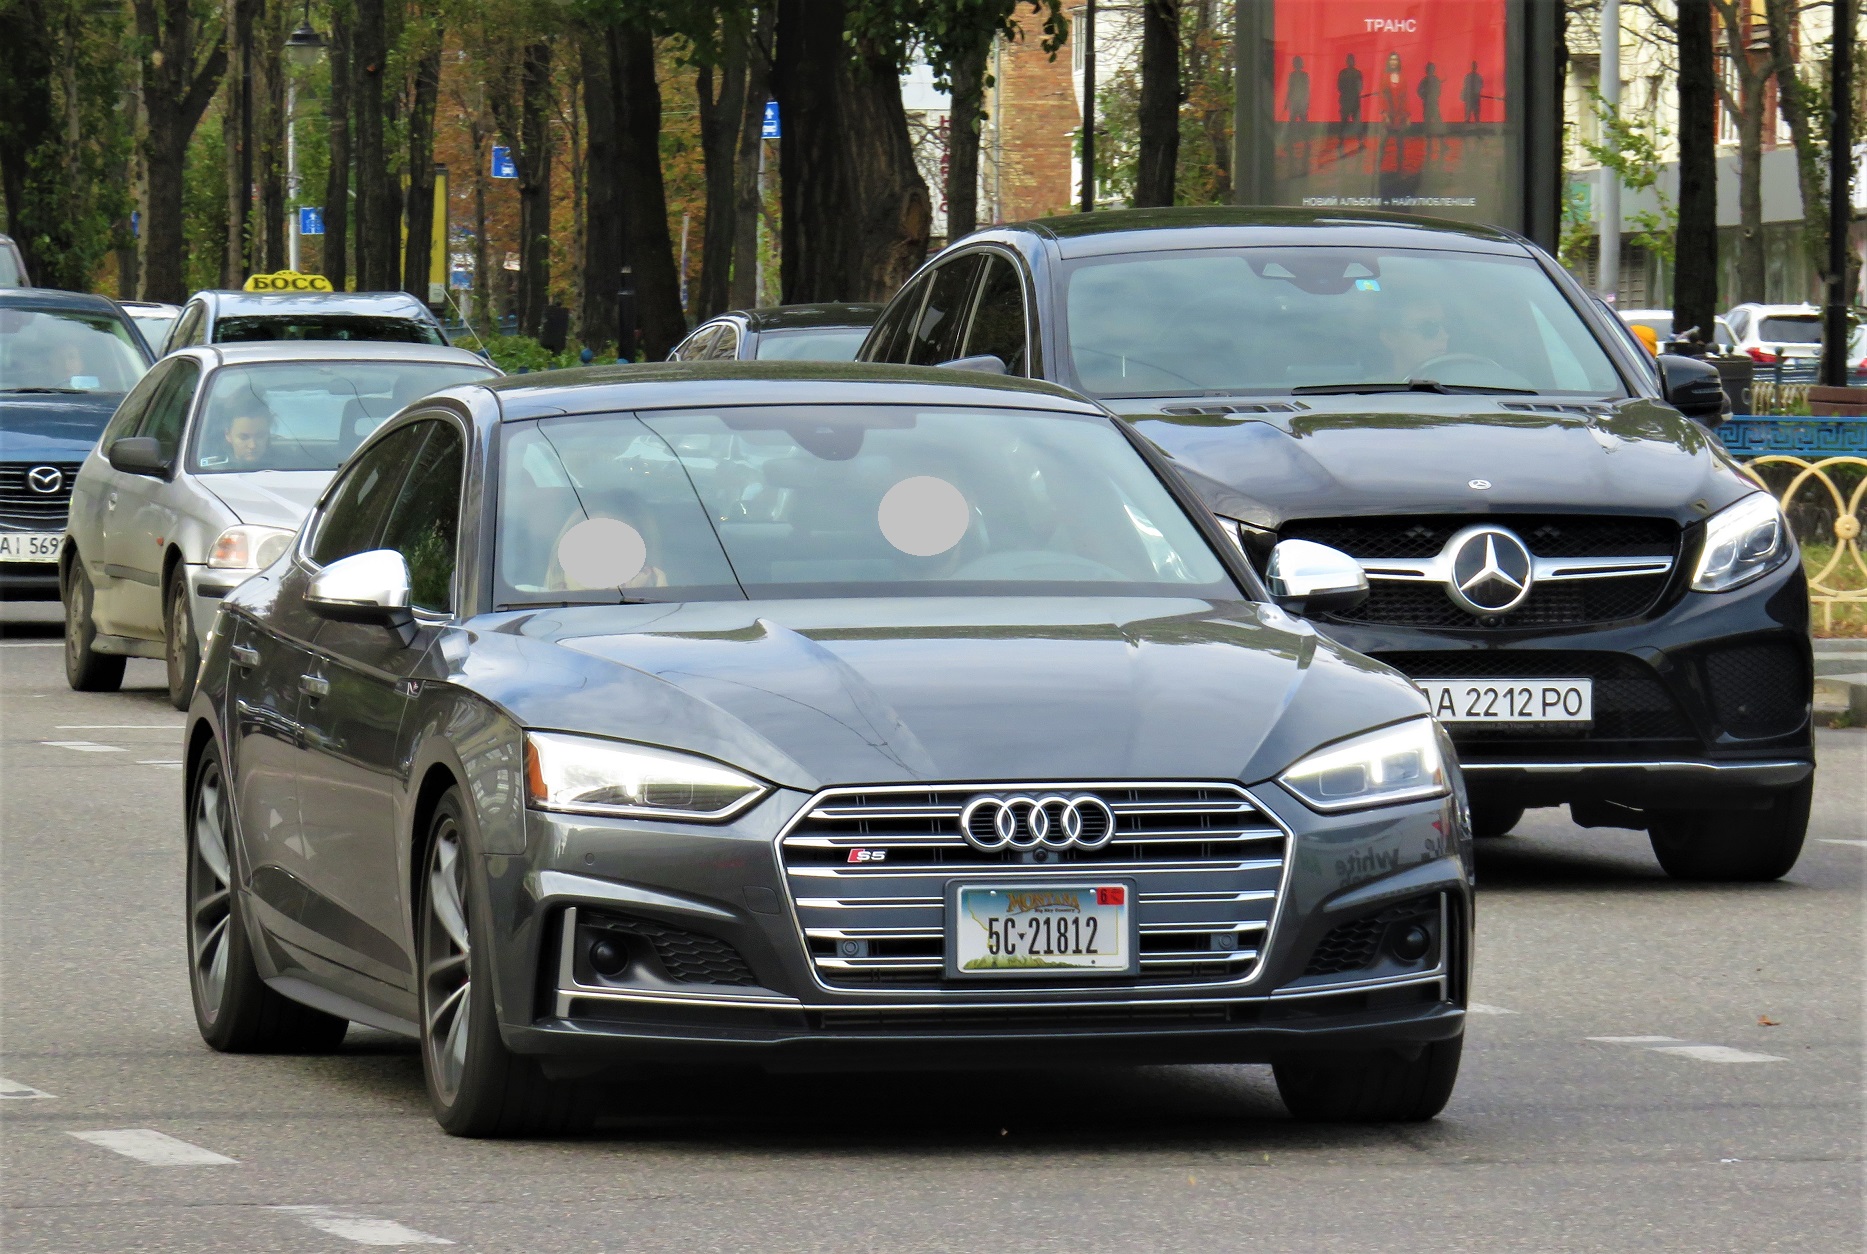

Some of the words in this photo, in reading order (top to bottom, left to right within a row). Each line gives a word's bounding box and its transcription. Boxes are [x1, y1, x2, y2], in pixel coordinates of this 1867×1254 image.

[1364, 18, 1417, 33] ТРАНС
[1302, 195, 1338, 206] НОВИЙ
[1339, 197, 1382, 206] АЛЬБОМ
[253, 277, 327, 290] БОСС
[29, 537, 65, 554] 569
[1465, 687, 1532, 717] 2212
[1541, 687, 1583, 717] PO
[856, 851, 886, 861] S5
[1006, 892, 1081, 913] MONTANA
[988, 917, 1016, 955] 5C
[1028, 916, 1098, 955] 21812
